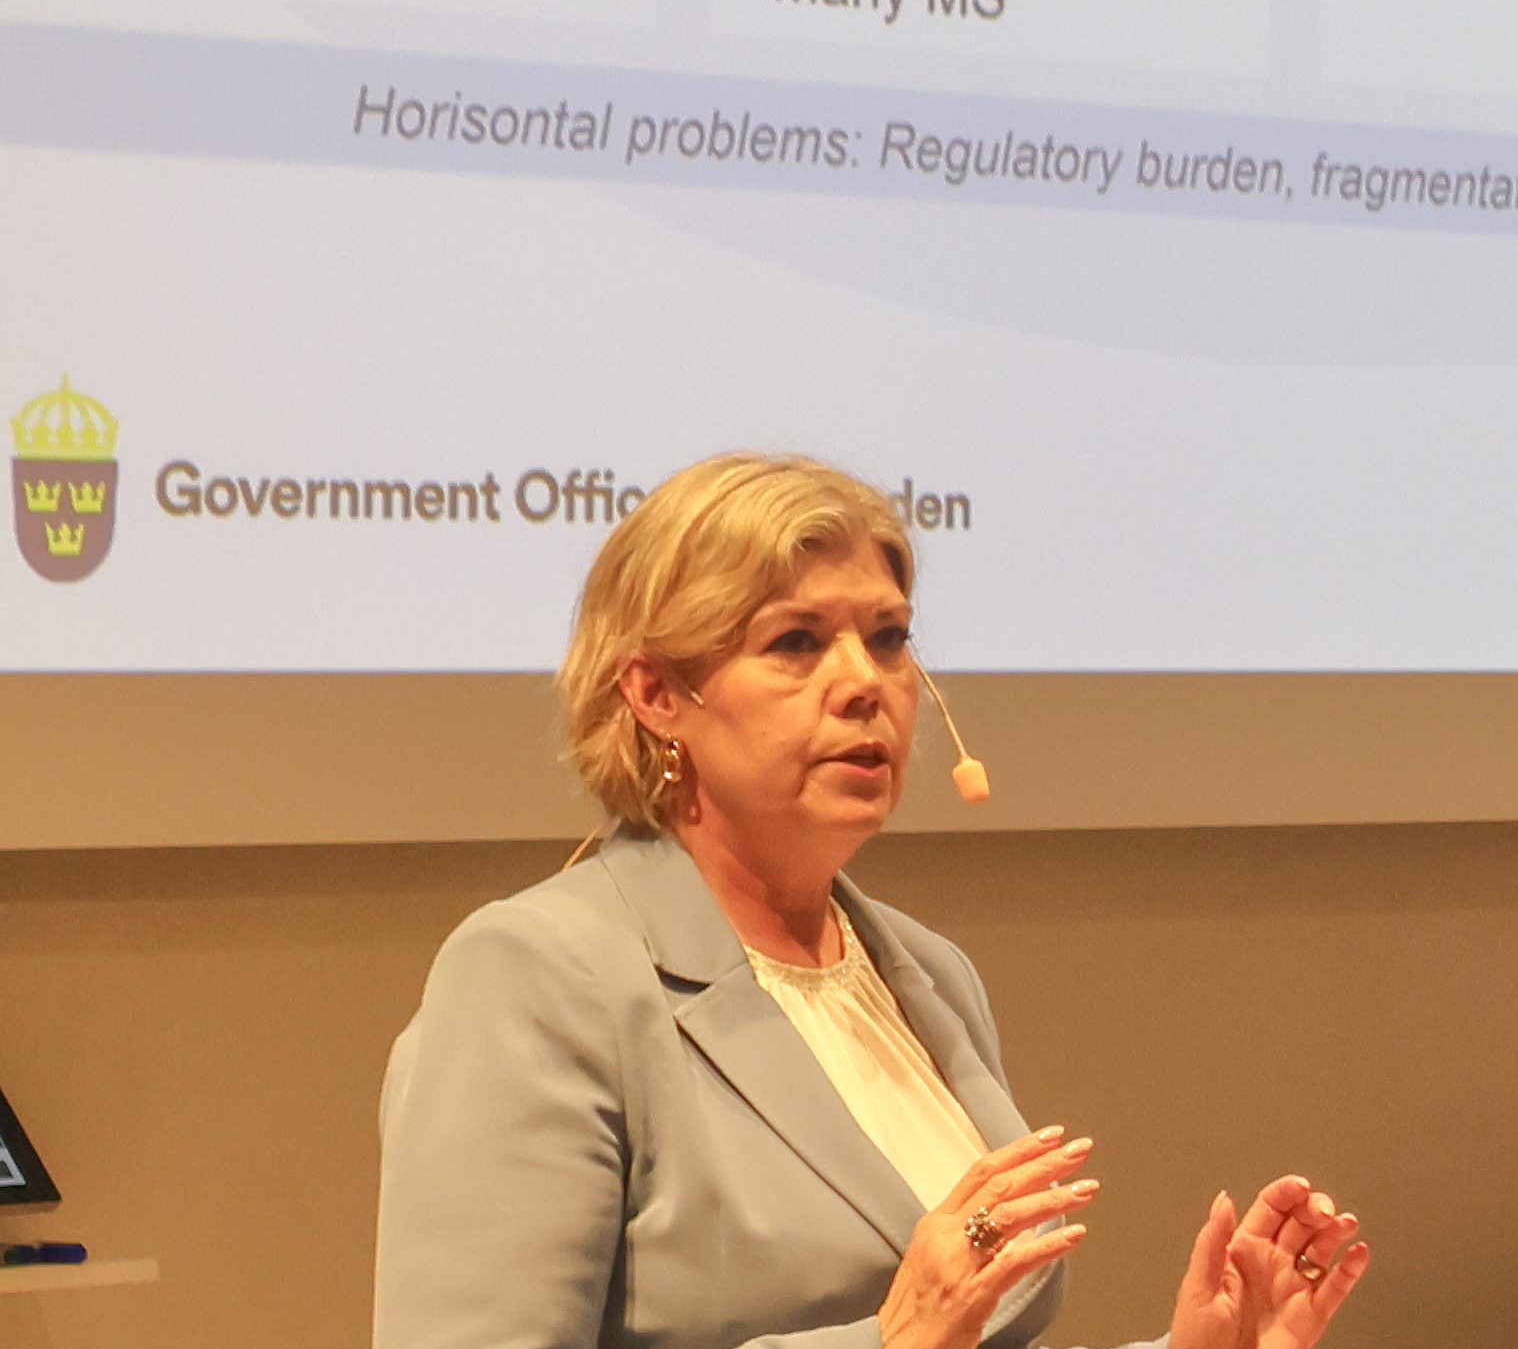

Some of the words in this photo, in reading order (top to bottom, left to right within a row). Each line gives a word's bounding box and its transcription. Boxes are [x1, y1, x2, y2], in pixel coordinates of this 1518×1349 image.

[353, 84, 613, 151] Horisontal
[625, 109, 862, 168] problems:
[879, 121, 1124, 195] Regulatory
[1136, 139, 1293, 202] burden,
[156, 458, 500, 523] Government
[514, 466, 647, 523] Offic
